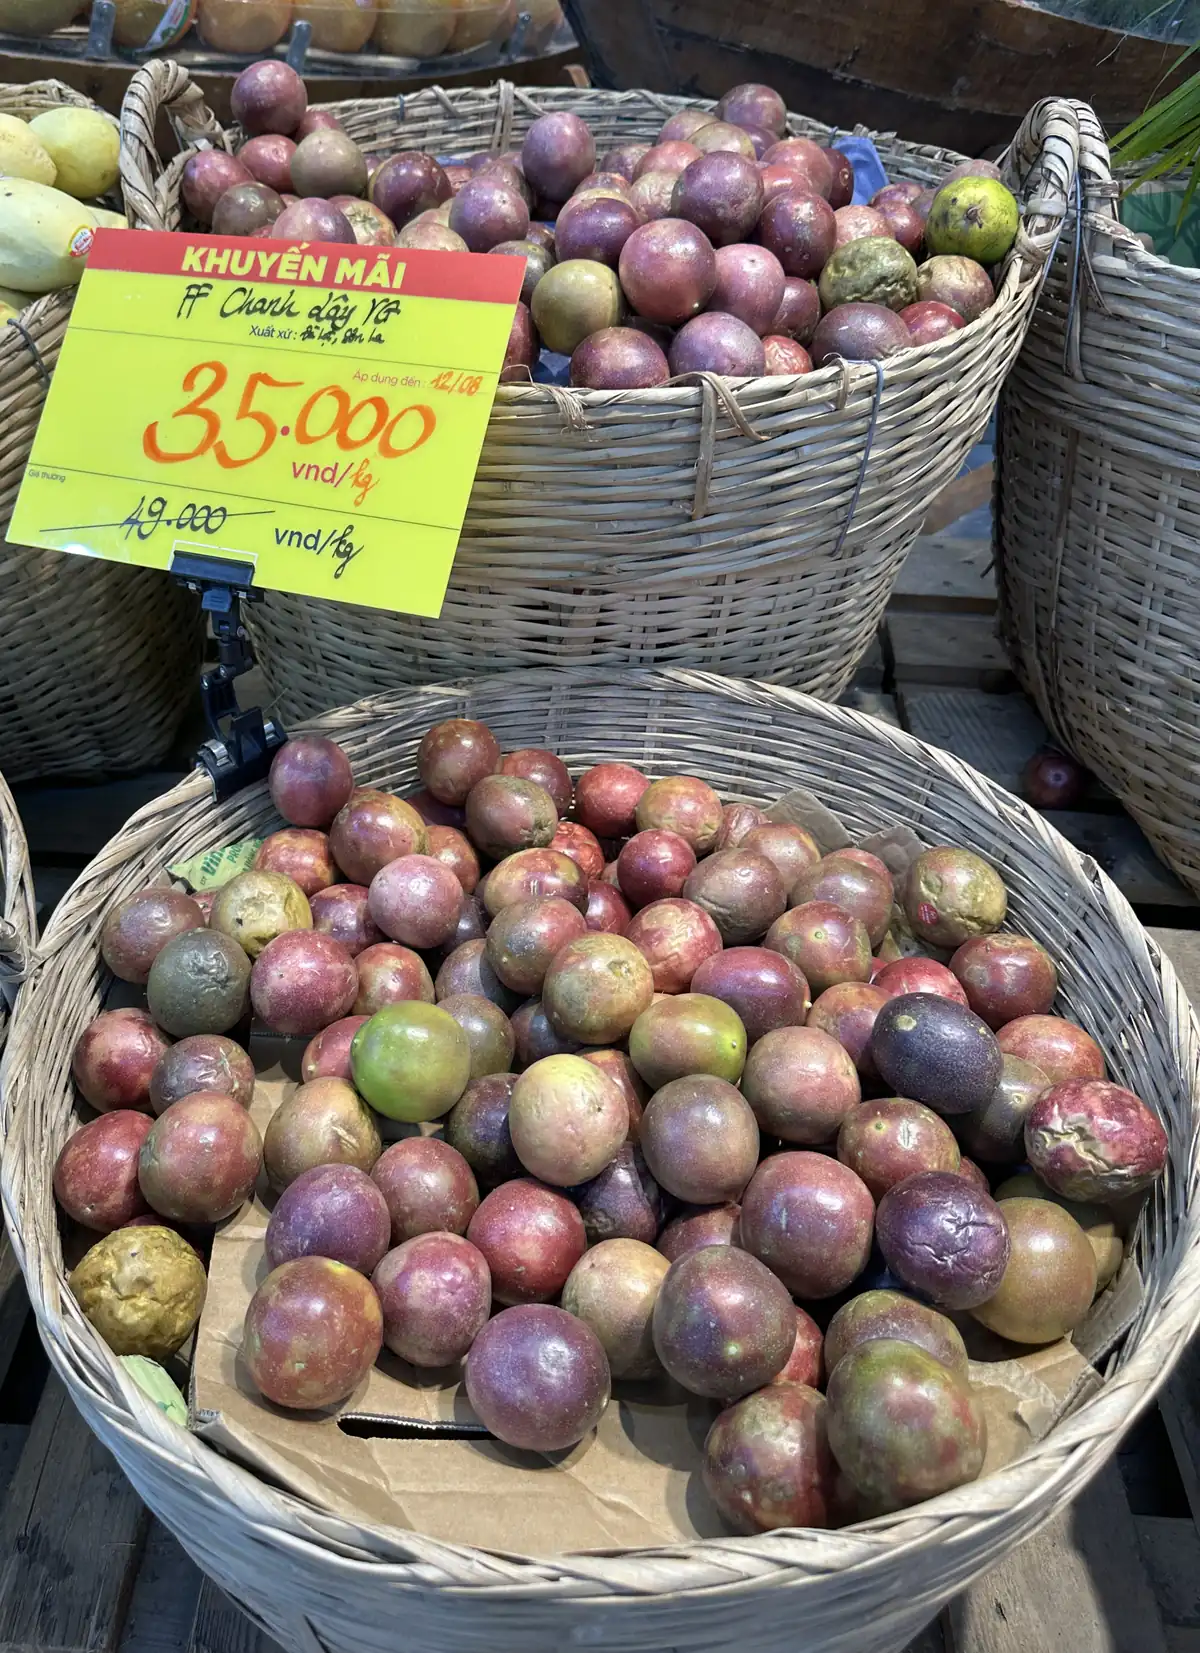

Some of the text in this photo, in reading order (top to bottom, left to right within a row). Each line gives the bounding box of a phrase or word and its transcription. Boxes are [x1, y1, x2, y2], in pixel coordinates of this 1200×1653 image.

[181, 242, 407, 289] KHUYẾN MÃI
[219, 286, 301, 319] Chanh
[249, 325, 275, 338] Xuất
[431, 370, 484, 397] 12/08
[142, 360, 437, 469] 35.000
[119, 495, 227, 540] 49.000
